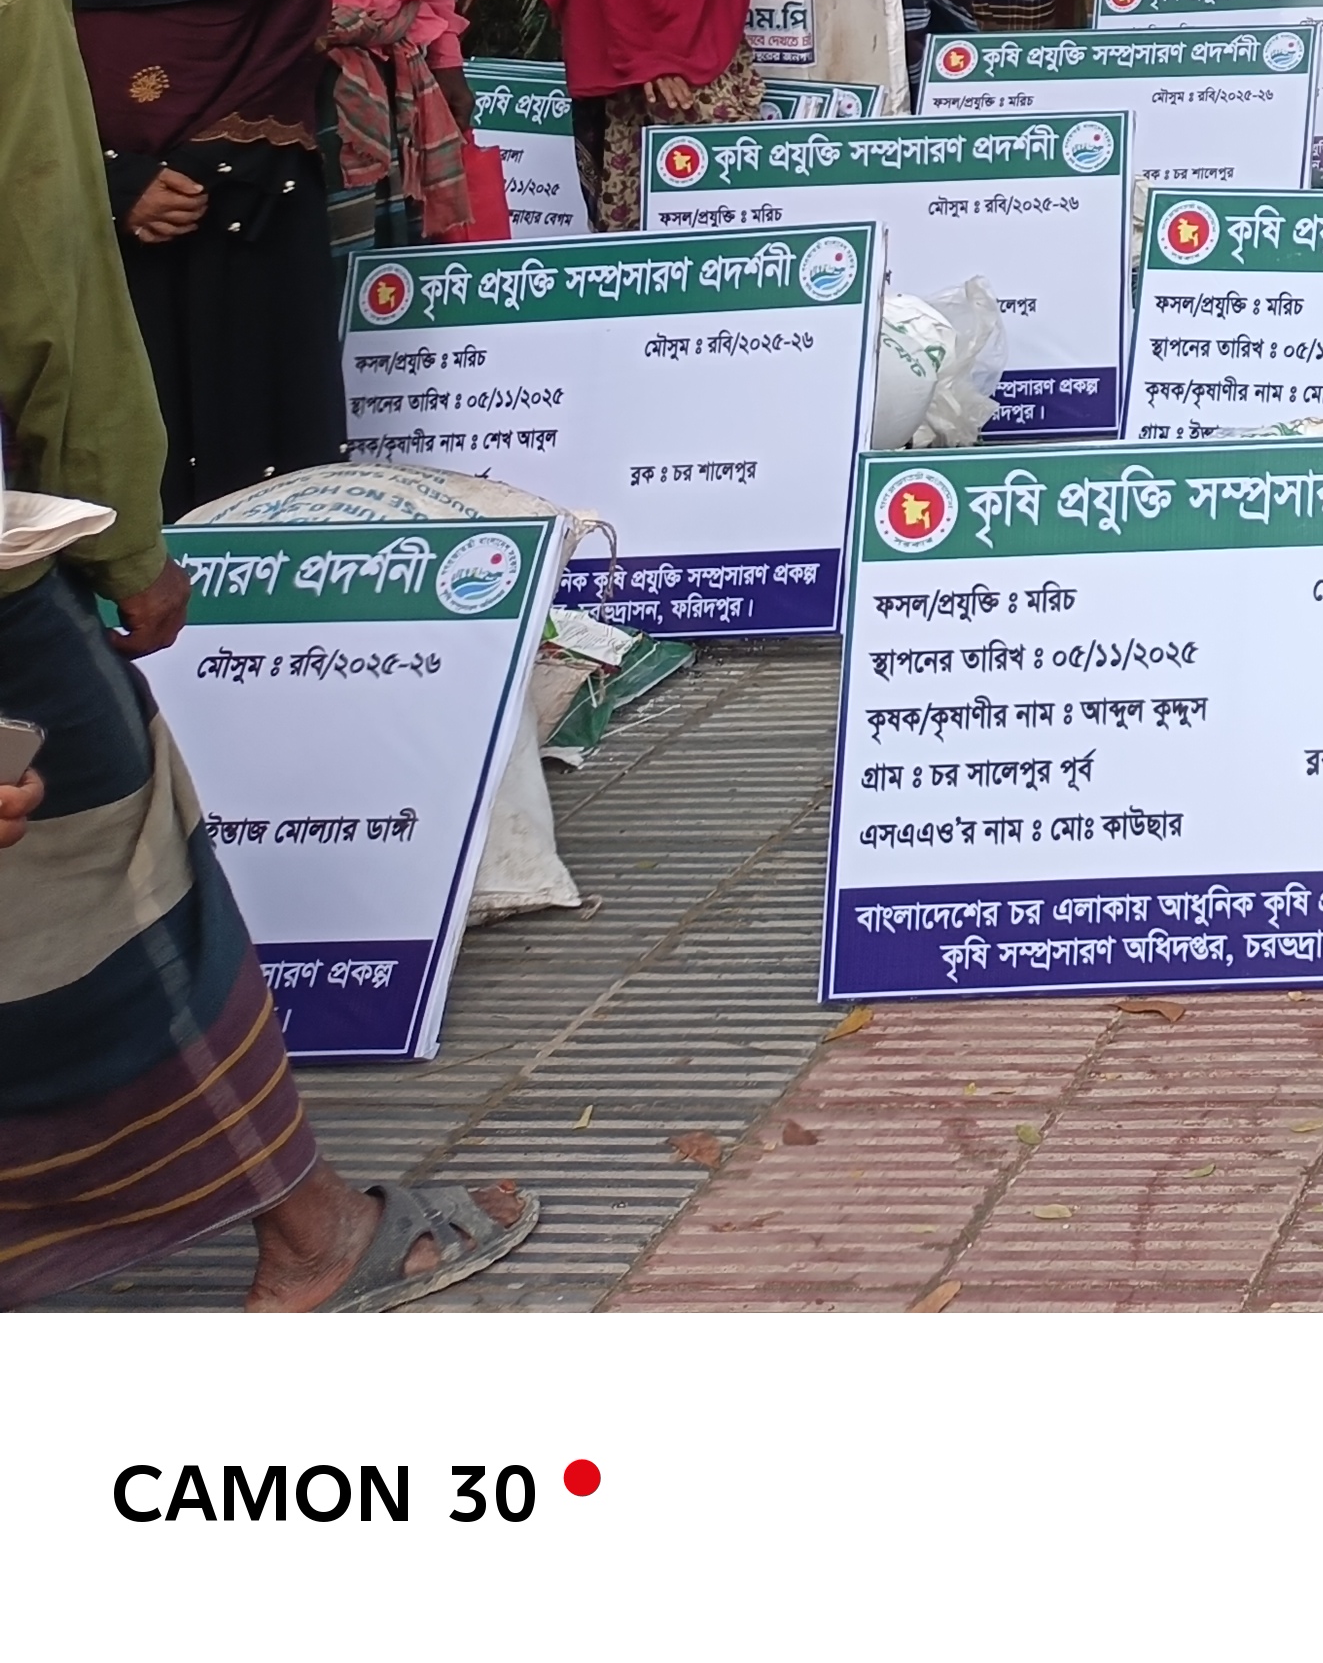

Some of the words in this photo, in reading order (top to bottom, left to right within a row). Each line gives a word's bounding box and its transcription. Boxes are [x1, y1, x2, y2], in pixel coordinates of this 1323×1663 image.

[474, 85, 513, 124] কৃষি
[515, 89, 572, 124] প্রযুক্তি
[1225, 205, 1286, 264] কৃষি
[419, 263, 472, 321] কৃষি
[478, 258, 558, 310] প্রযুক্তি
[564, 256, 693, 301] সম্প্রসারণ
[699, 242, 796, 291] প্রদর্শনী
[1145, 376, 1249, 409] কৃষক/কৃষাণীর
[1254, 383, 1284, 402] নাম
[631, 466, 655, 486] ব্লক
[672, 465, 693, 481] চর
[698, 461, 757, 484] শালেপুর
[965, 469, 1047, 548] কৃষি
[1058, 465, 1176, 535] প্রযুক্তি
[873, 584, 1000, 622] ফসল/প্রযুক্তি
[1025, 581, 1077, 613] মরিচ
[197, 647, 266, 684] মৌসুম
[290, 646, 440, 680] রবি/২০২৫-২৬
[869, 649, 954, 681] স্থাপনের
[960, 639, 1026, 672] তারিখ
[1053, 638, 1198, 672] ০৫/১১/২০২৫
[866, 695, 1008, 744] কৃষক/কৃষাণীর
[1014, 701, 1055, 727] নাম
[1080, 698, 1145, 729] আব্দুল
[1151, 698, 1208, 729] কুদ্দুস
[862, 763, 904, 791] গ্রাম
[929, 764, 960, 787] চর
[965, 759, 1052, 791] সালেপুর
[1060, 749, 1096, 791] পূর্ব
[982, 817, 1024, 844] নাম
[1051, 813, 1094, 841] মোঃ
[1101, 806, 1184, 841] কাউছার
[855, 900, 1002, 933] বাংলাদেশের
[1007, 900, 1044, 925] চর
[1053, 894, 1152, 924] এলাকায়
[1157, 885, 1256, 926] আধুনিক
[1261, 882, 1312, 929] কৃষি
[328, 959, 398, 988] প্রকল্প
